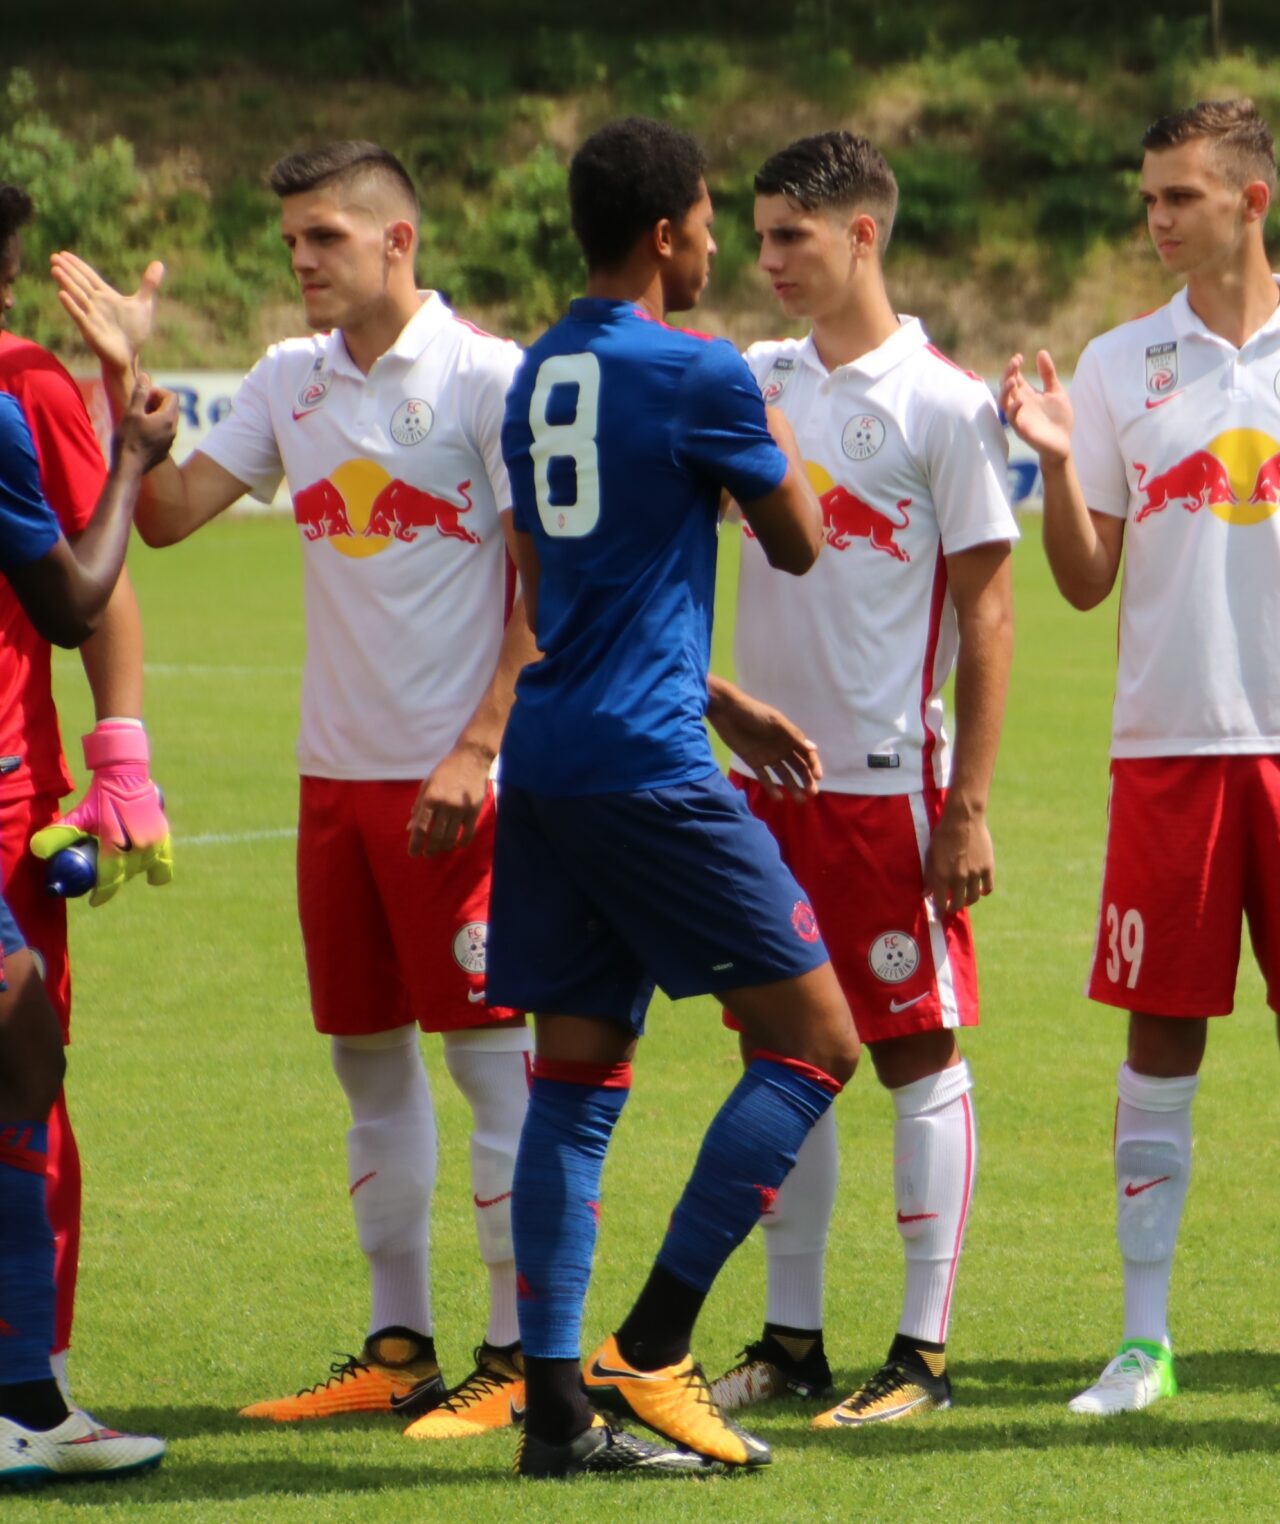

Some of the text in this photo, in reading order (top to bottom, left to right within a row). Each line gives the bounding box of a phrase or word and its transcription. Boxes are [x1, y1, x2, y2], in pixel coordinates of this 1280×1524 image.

[528, 351, 601, 537] 8
[884, 935, 899, 949] FC
[1106, 903, 1144, 989] 39
